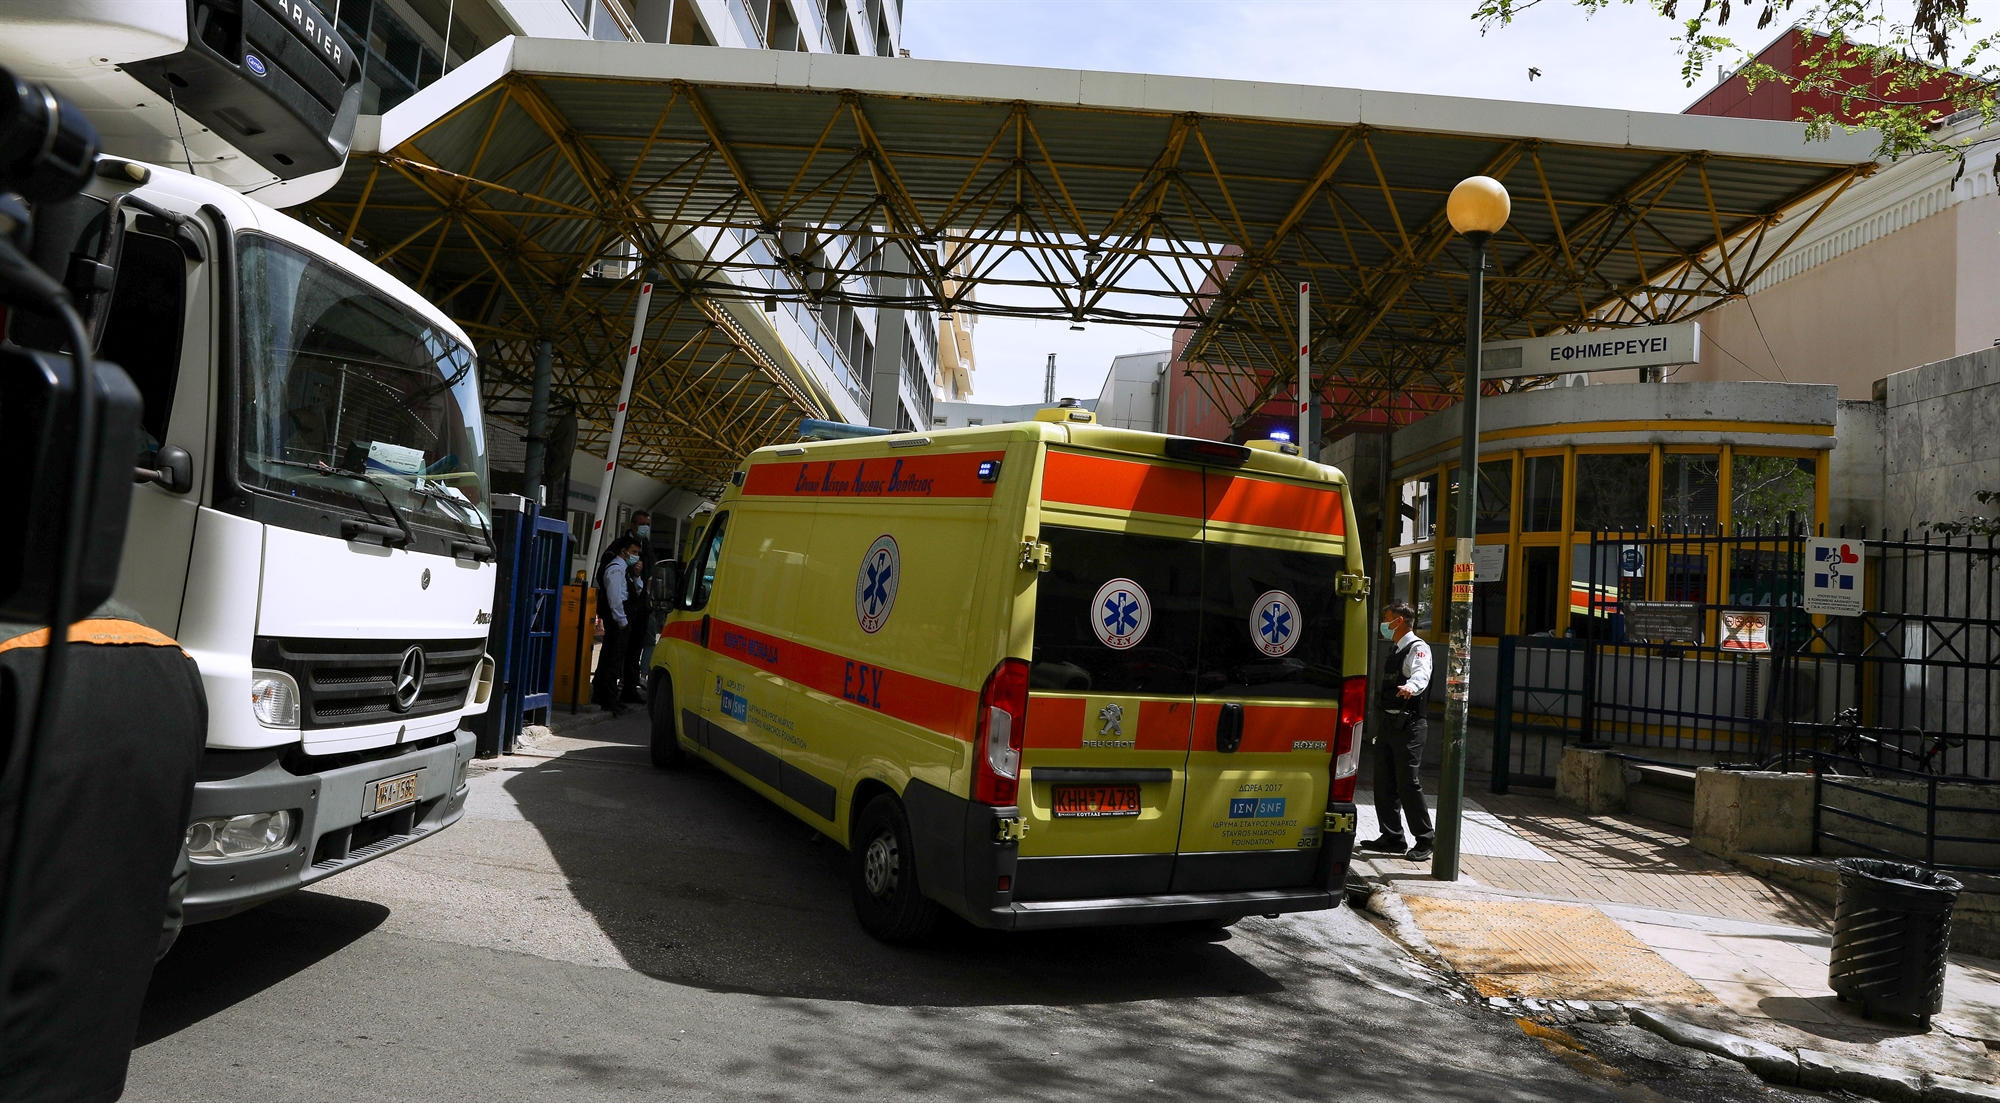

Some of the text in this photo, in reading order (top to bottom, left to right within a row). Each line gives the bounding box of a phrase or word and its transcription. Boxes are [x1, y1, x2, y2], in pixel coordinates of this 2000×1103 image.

[279, 0, 341, 64] ARRIER
[1550, 337, 1667, 361] ΕΦΗΜΕΡΕΥΕΙ
[722, 696, 732, 710] ΙΣΝ
[733, 701, 746, 716] SNF
[1082, 740, 1135, 748] PEUGEOT
[1293, 740, 1327, 749] BOXER
[1239, 784, 1283, 792] ΔΩΡΕΑ 2017
[1233, 803, 1253, 814] ΙΣΝ
[1260, 803, 1282, 813] SNF
[1212, 819, 1298, 829] ΙΔΡΥΜΑ ΣΤΑΥΡΟΣ ΝΙΑΡΧΟΣ
[1222, 828, 1287, 837] STAVROS NIARCHOS
[1231, 838, 1275, 846] FOUNDATION
